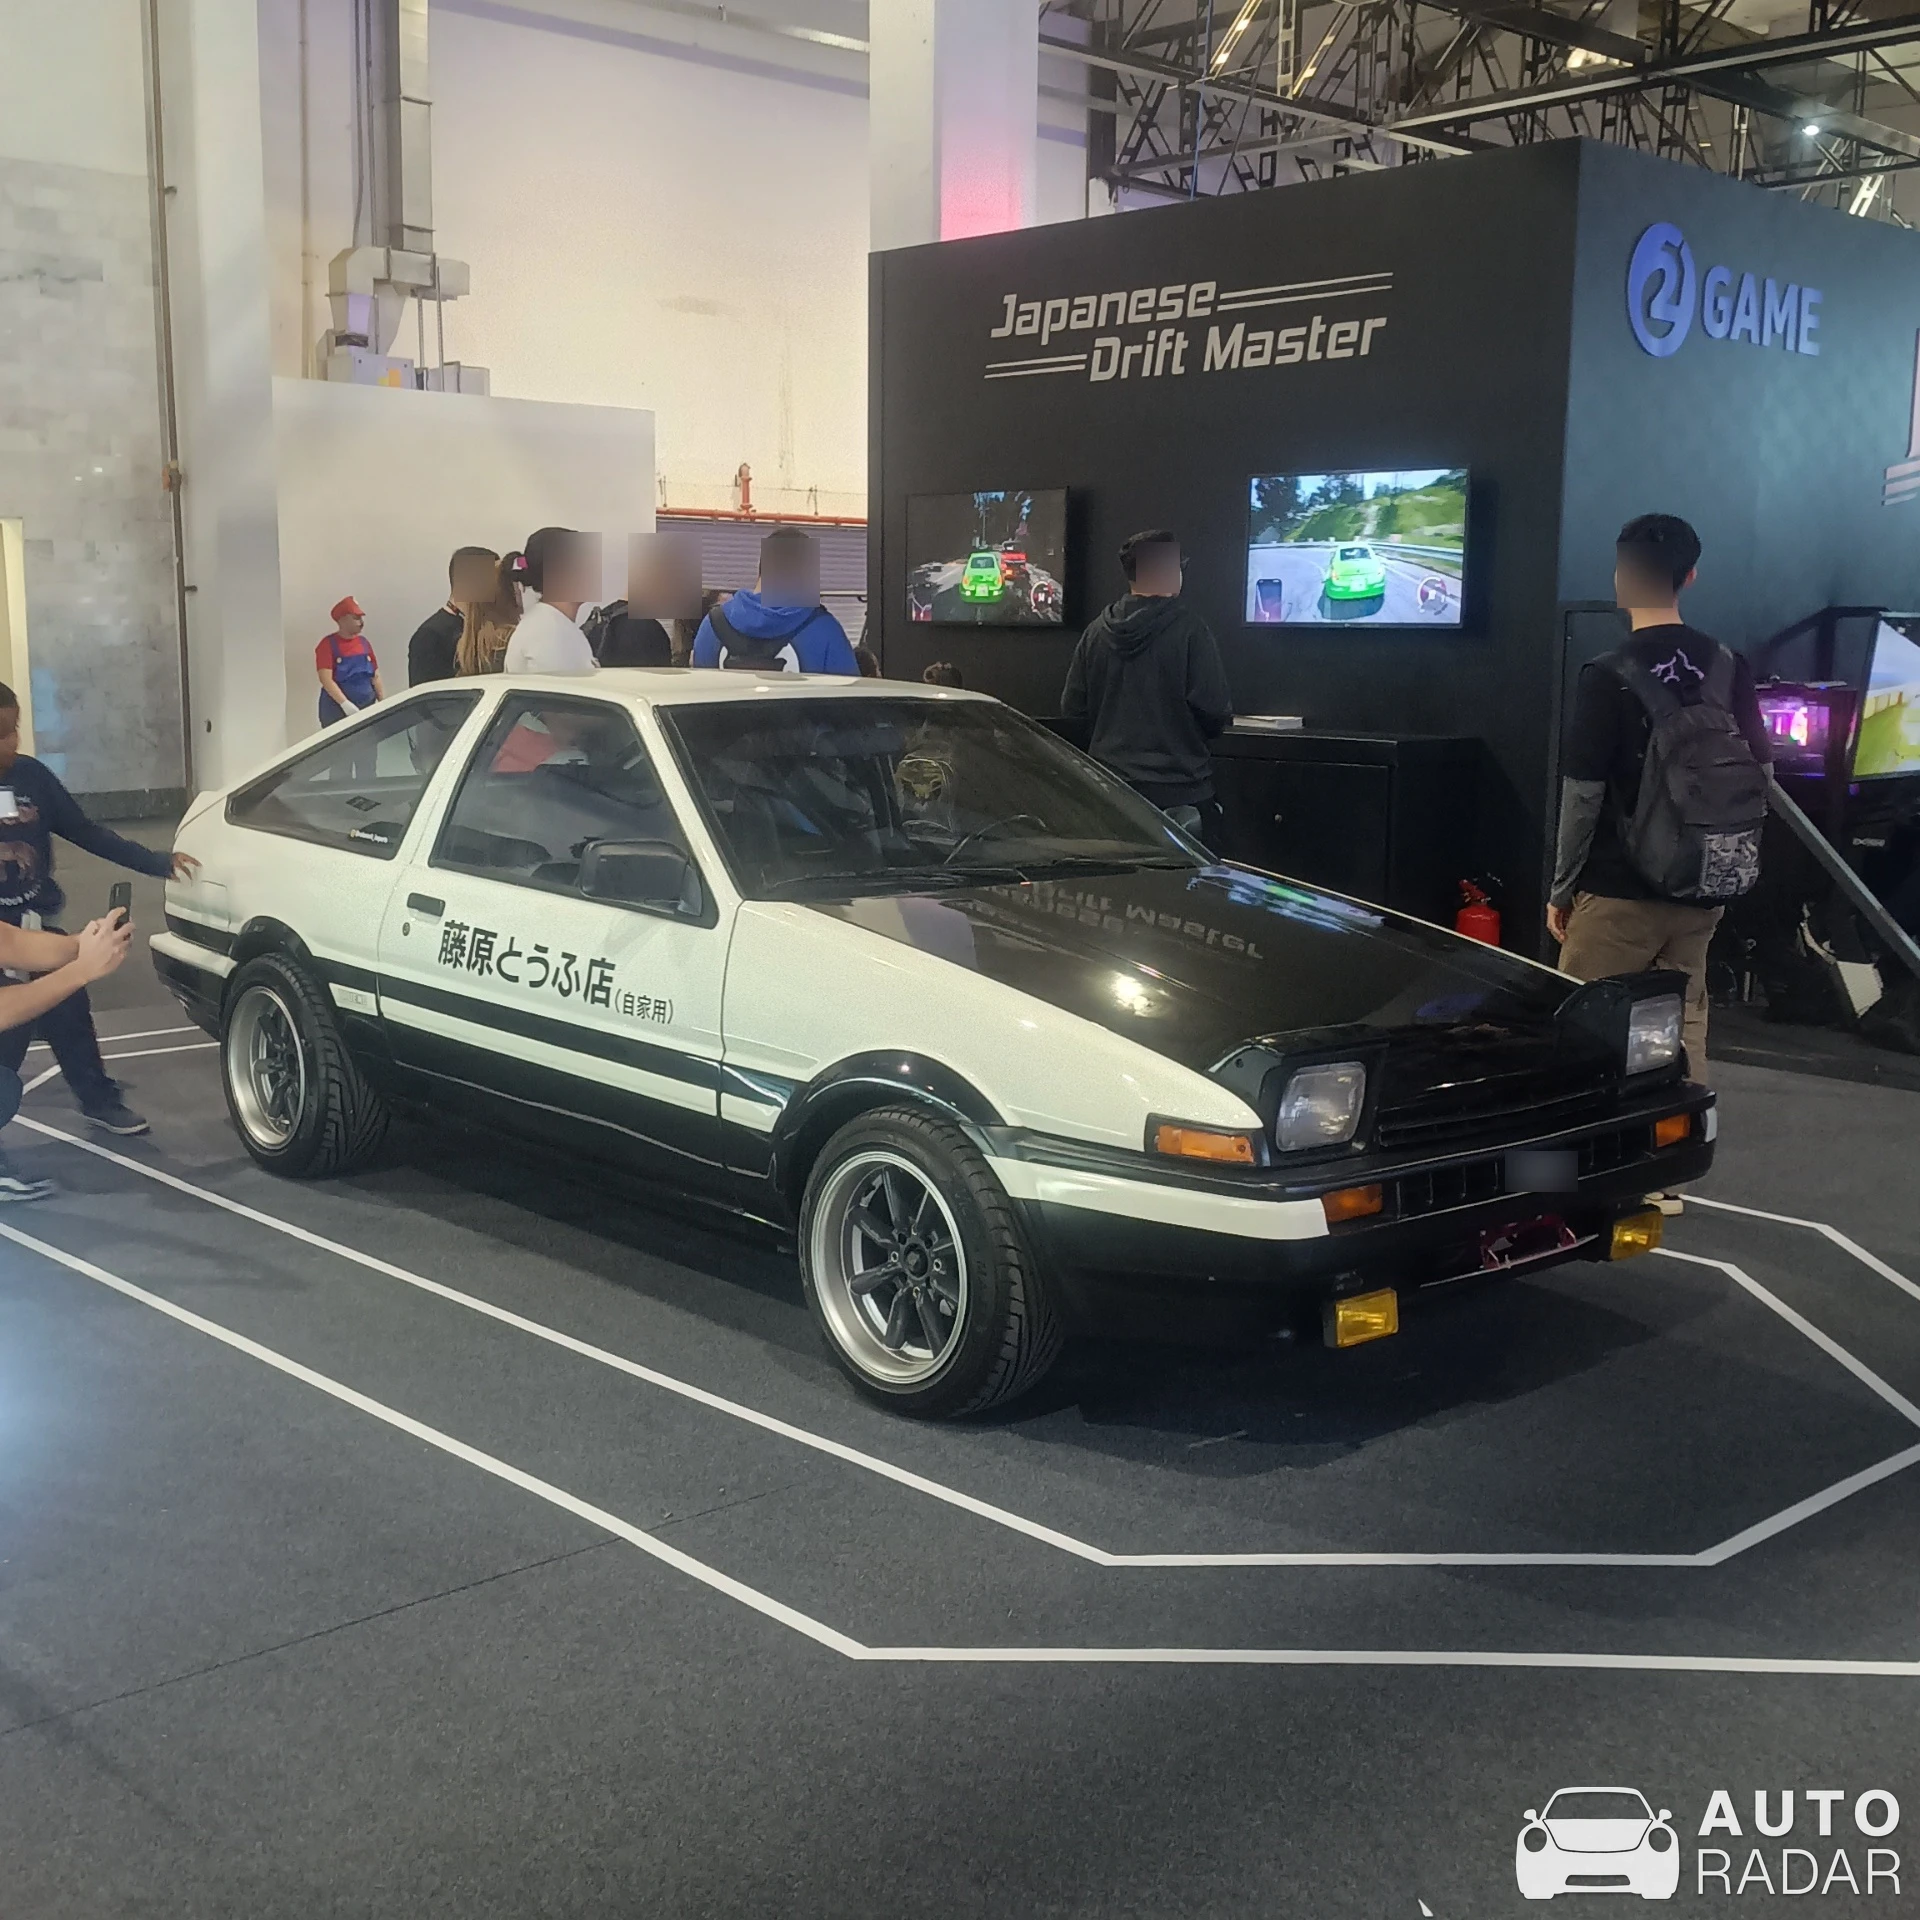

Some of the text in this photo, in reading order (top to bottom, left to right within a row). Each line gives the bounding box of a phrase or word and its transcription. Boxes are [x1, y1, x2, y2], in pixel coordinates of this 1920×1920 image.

[991, 281, 1217, 344] Japanese
[1703, 265, 1824, 356] GAME
[1090, 315, 1387, 382] Drift Master
